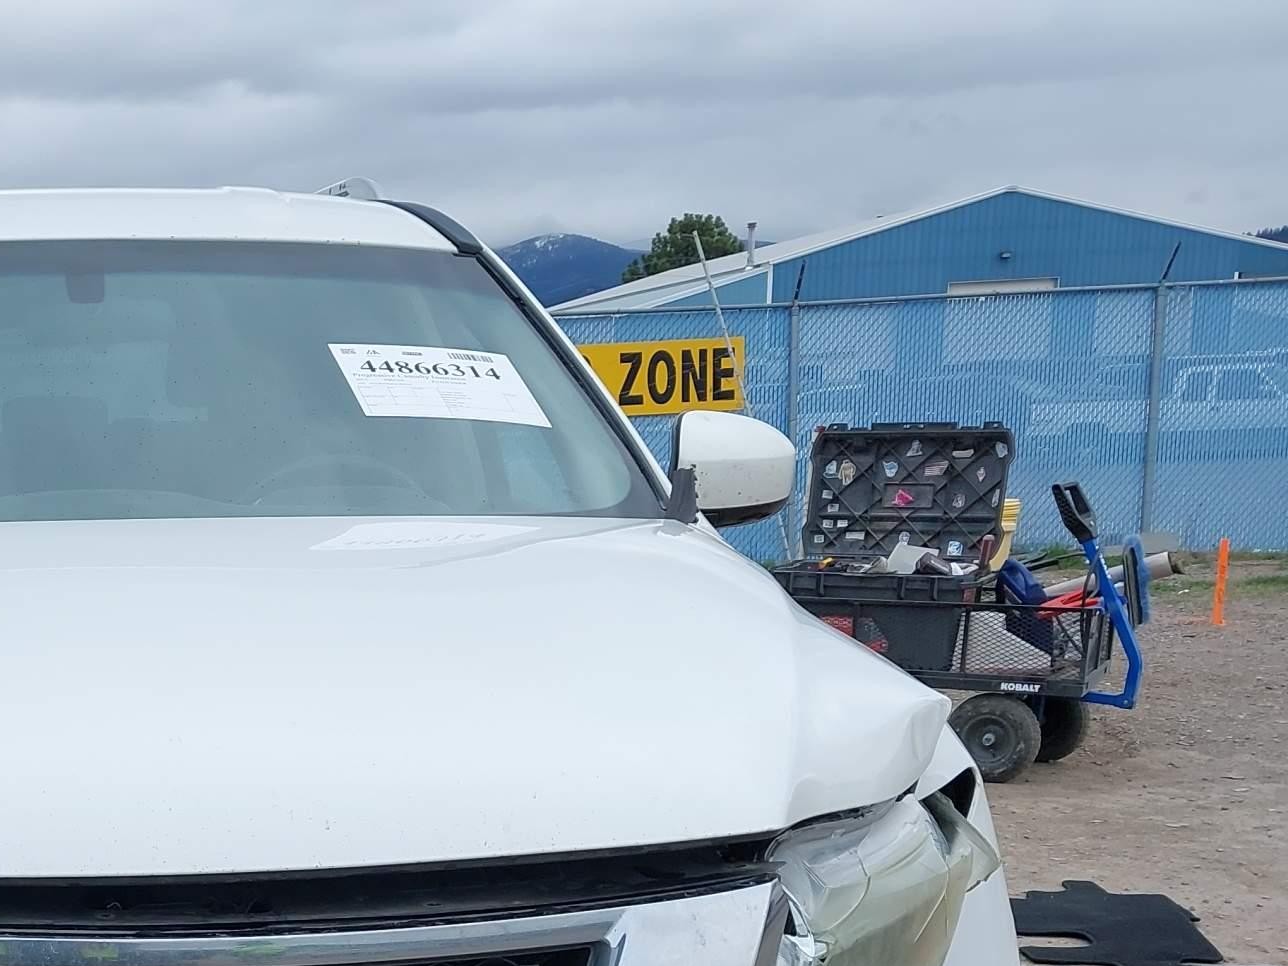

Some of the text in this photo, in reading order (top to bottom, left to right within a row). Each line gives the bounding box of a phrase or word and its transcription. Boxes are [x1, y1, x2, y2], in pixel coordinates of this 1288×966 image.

[359, 359, 502, 381] 44866314
[618, 347, 736, 406] ZONE
[1000, 682, 1041, 693] KOBALT
